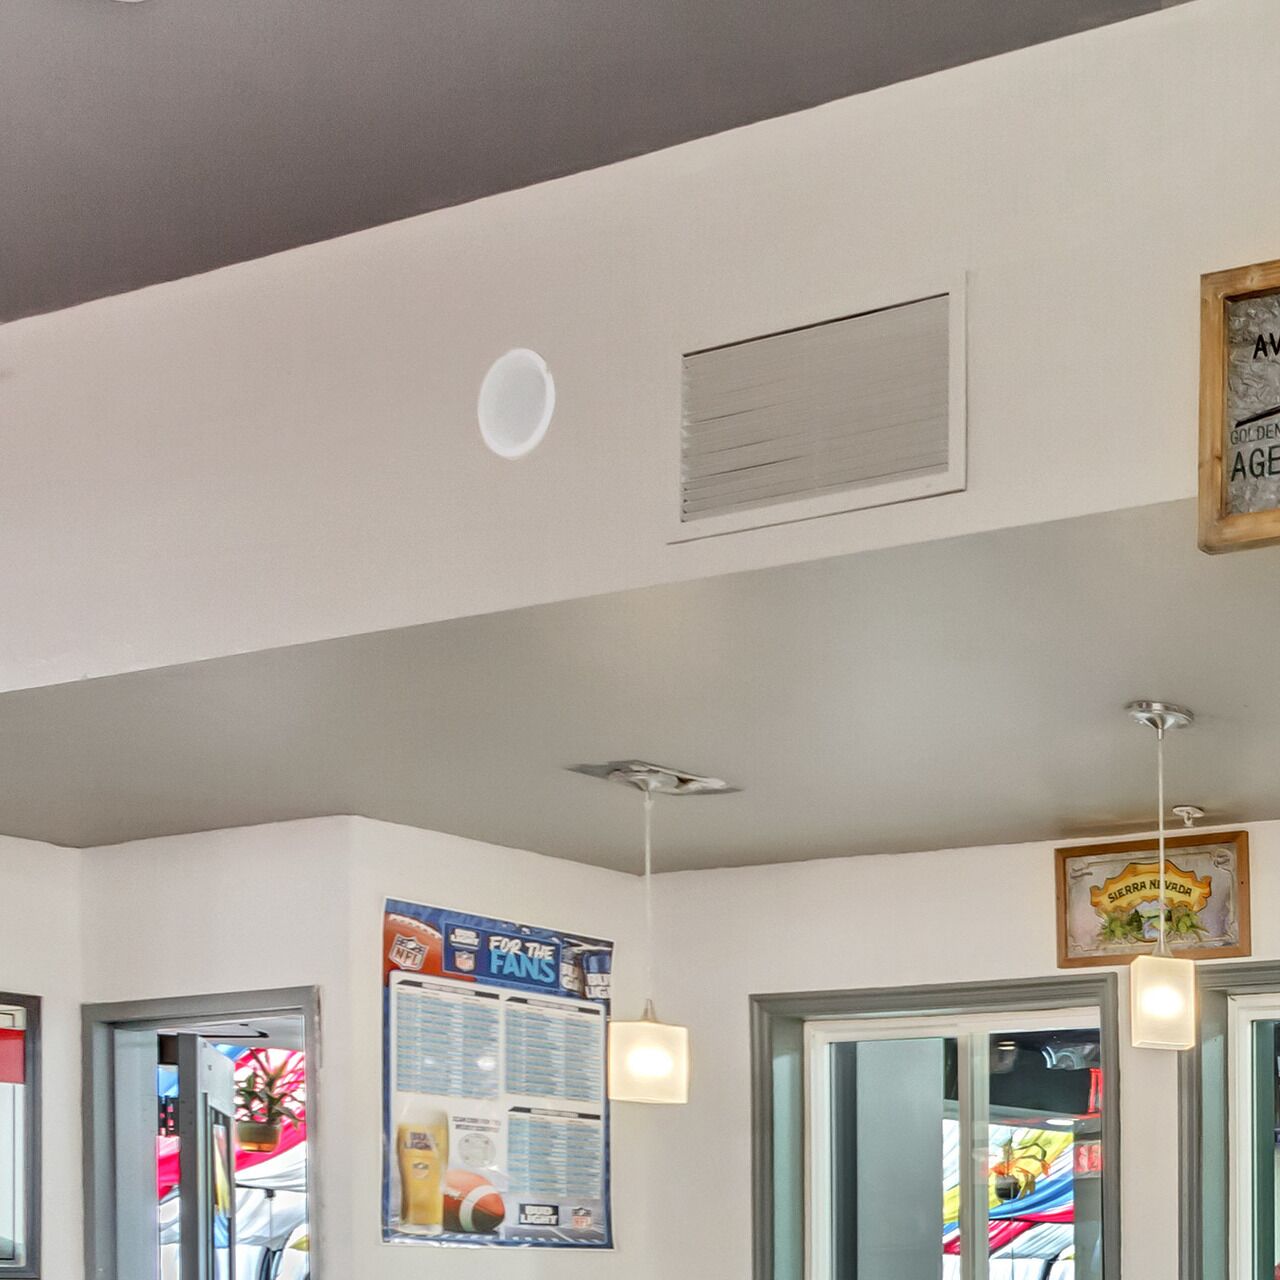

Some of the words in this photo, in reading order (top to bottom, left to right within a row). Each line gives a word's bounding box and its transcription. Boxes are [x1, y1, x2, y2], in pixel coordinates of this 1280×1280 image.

[1107, 880, 1147, 903] SIERRA
[488, 936, 522, 955] FOR
[524, 942, 556, 960] THE
[490, 949, 556, 984] FANS
